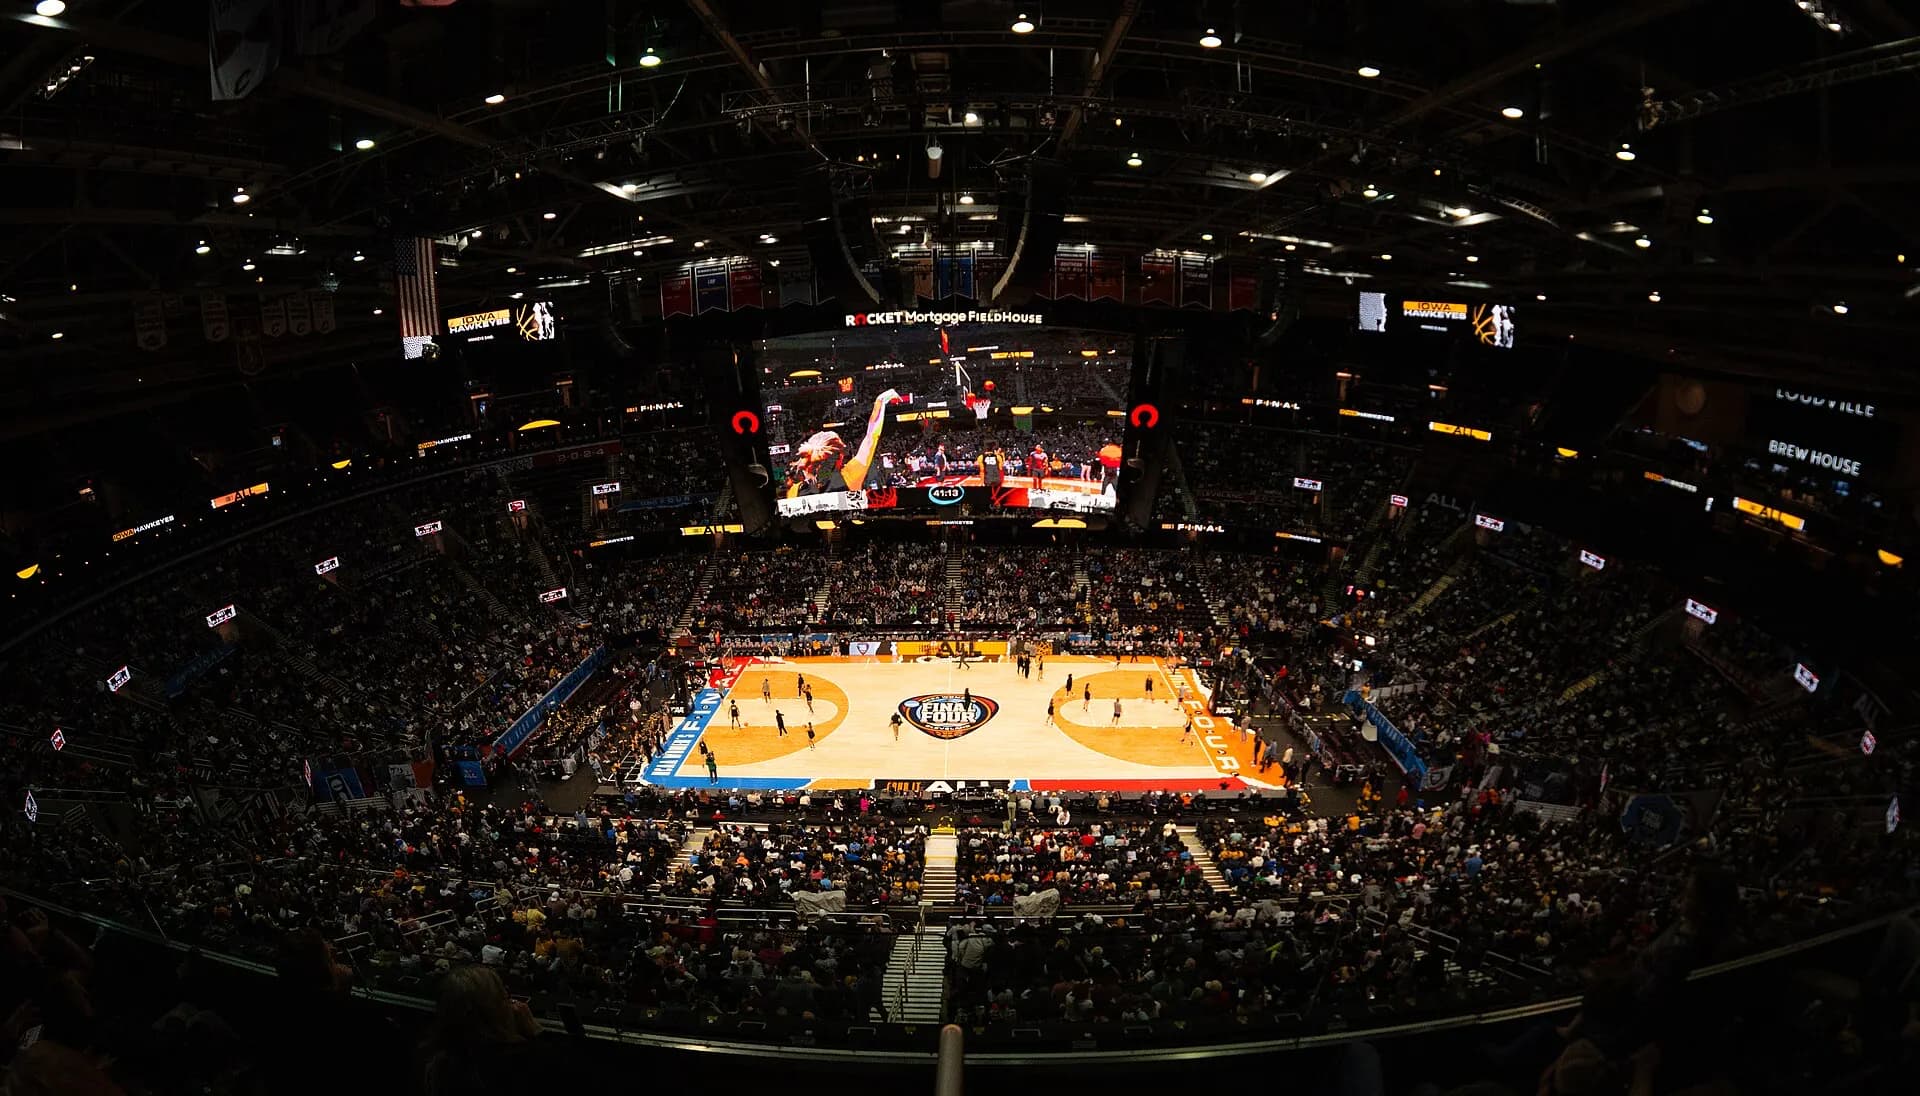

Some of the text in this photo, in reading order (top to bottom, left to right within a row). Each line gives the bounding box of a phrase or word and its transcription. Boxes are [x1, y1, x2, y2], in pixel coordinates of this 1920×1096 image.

[1417, 302, 1451, 311] IOWA
[461, 312, 496, 325] IOWA
[846, 311, 1042, 326] ROCKET Mortgage FIELDHOUSE
[1403, 310, 1467, 320] HAWKEYES
[449, 318, 510, 334] HAWKEYES
[1768, 439, 1862, 477] BREW HOUSE
[933, 489, 959, 497] 41:13
[936, 641, 982, 658] ALL
[922, 702, 976, 712] FINAL
[920, 711, 977, 723] FOUR
